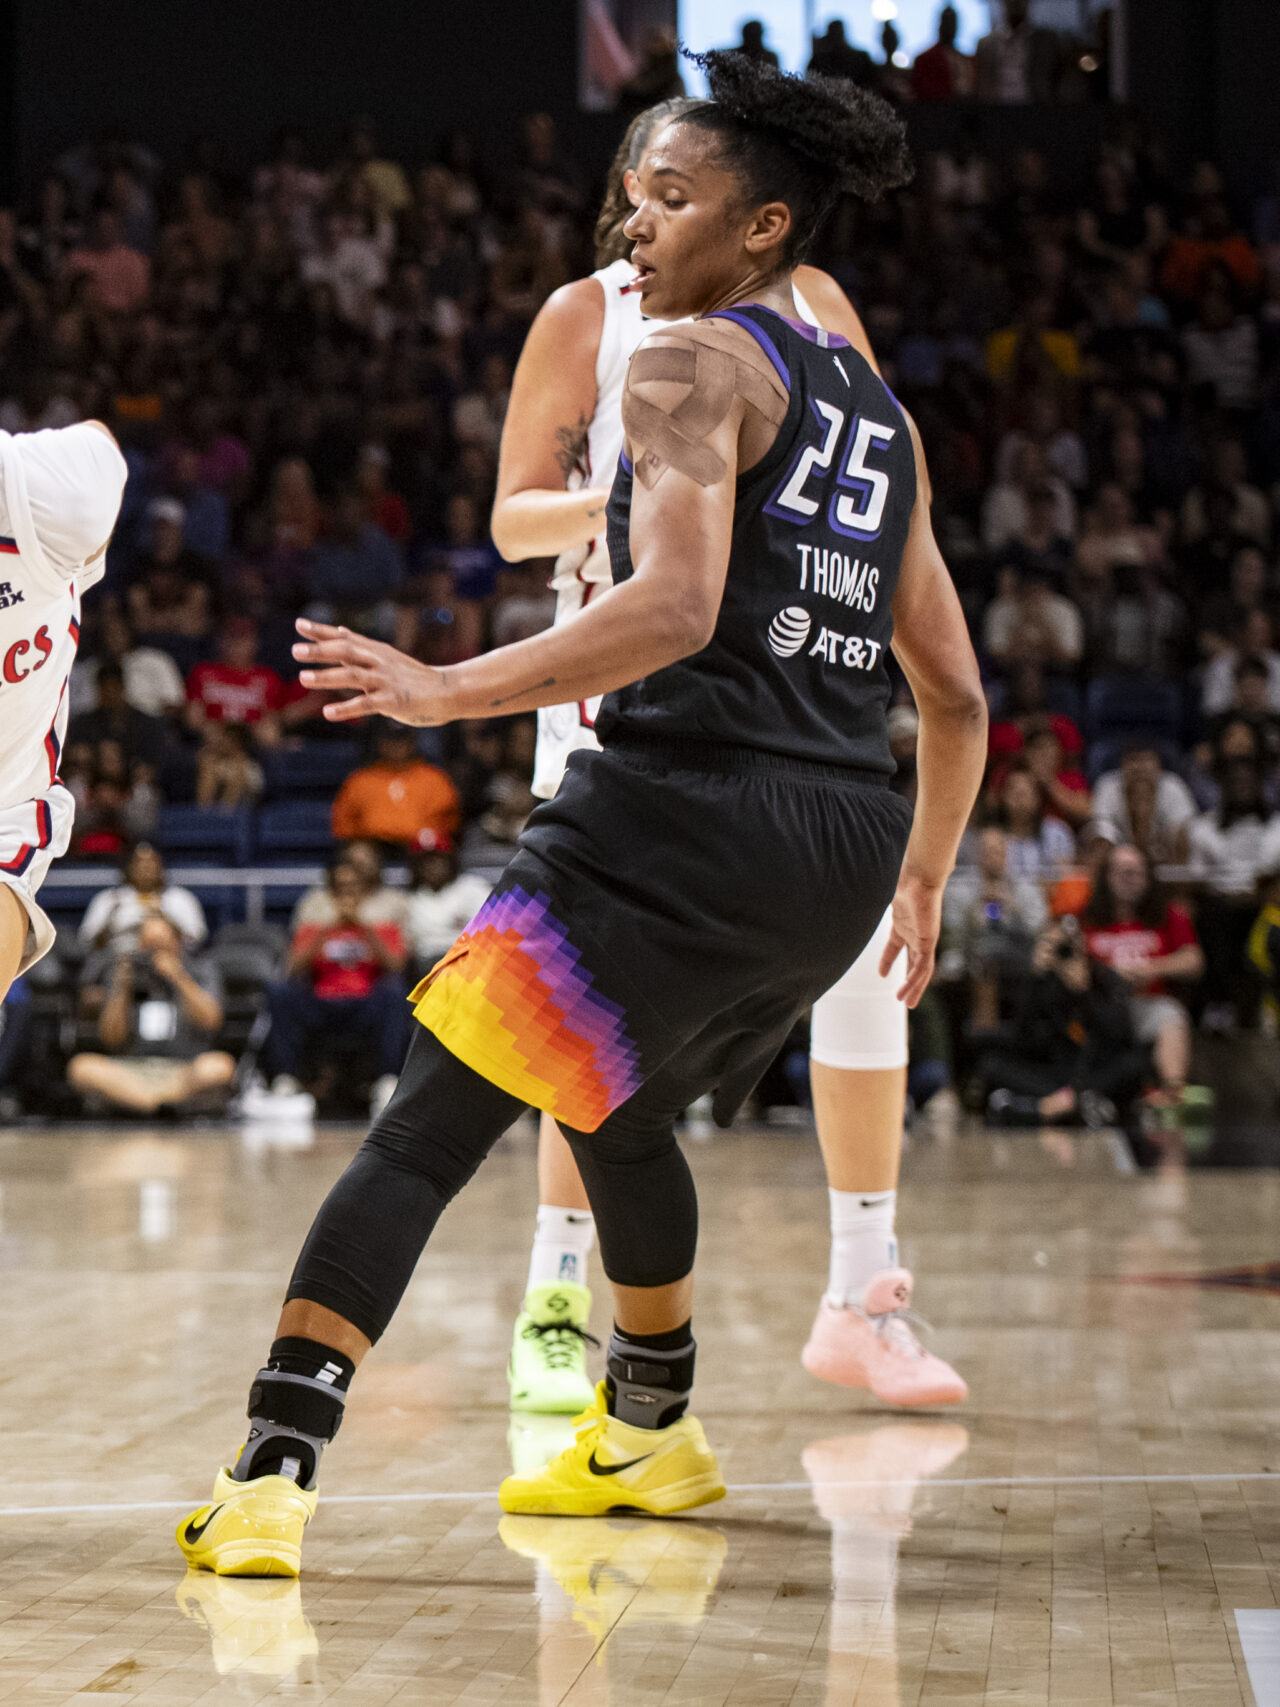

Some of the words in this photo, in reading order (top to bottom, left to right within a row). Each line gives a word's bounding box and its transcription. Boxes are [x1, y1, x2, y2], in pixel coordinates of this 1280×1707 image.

[763, 397, 896, 541] 25
[796, 544, 880, 613] THOMAS
[809, 627, 882, 671] AT&T
